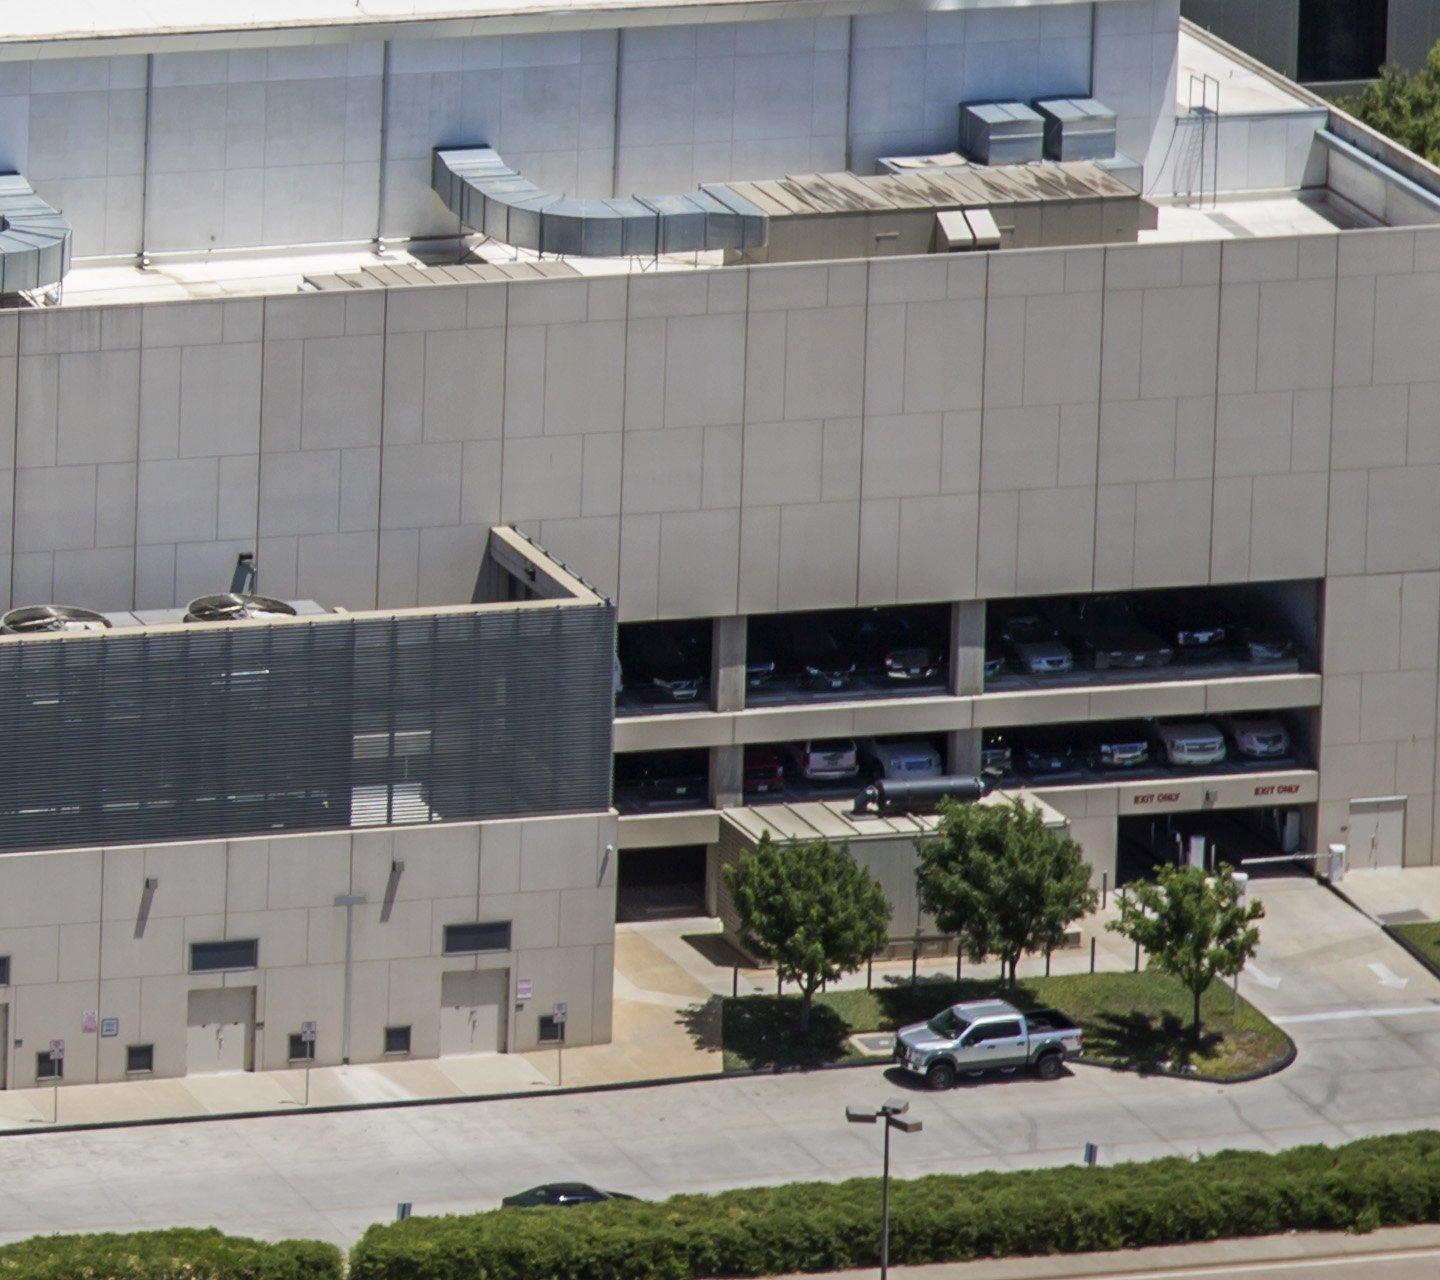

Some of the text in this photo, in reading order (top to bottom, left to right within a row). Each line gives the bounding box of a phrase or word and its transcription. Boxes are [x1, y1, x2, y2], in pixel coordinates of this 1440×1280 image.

[1254, 783, 1301, 796] EXIT ONLY
[1134, 792, 1180, 804] EXIT ONLY
